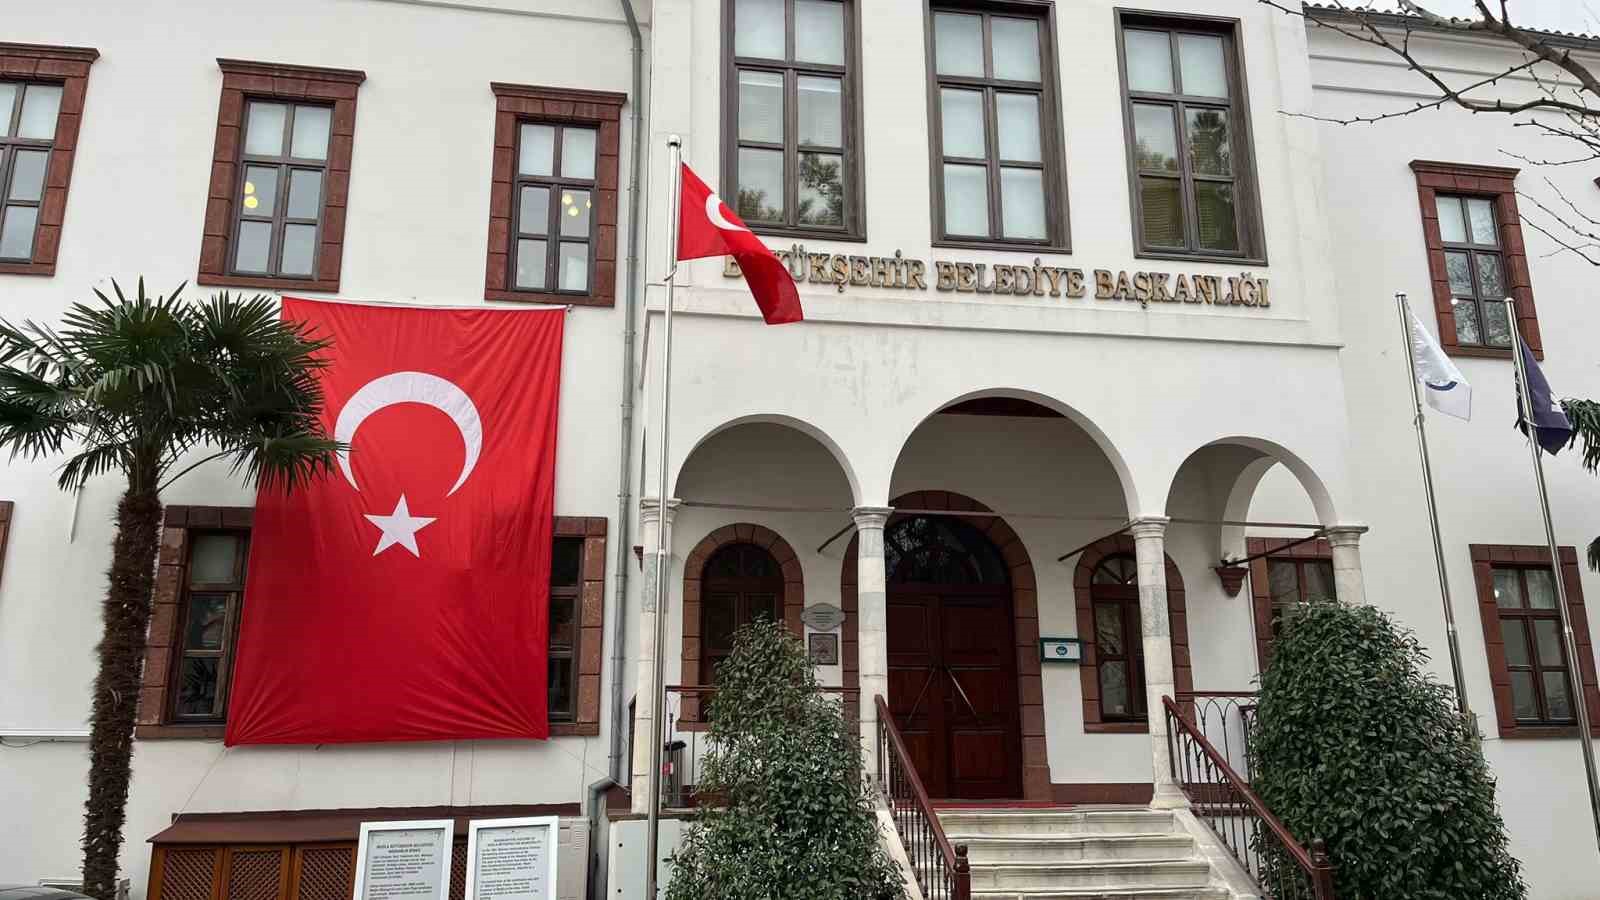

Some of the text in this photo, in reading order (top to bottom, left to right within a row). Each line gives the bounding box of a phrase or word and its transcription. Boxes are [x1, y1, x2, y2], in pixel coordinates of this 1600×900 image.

[723, 243, 1271, 309] BÜKŞEHİR BELEDİYE BAŞKANLIĞI
